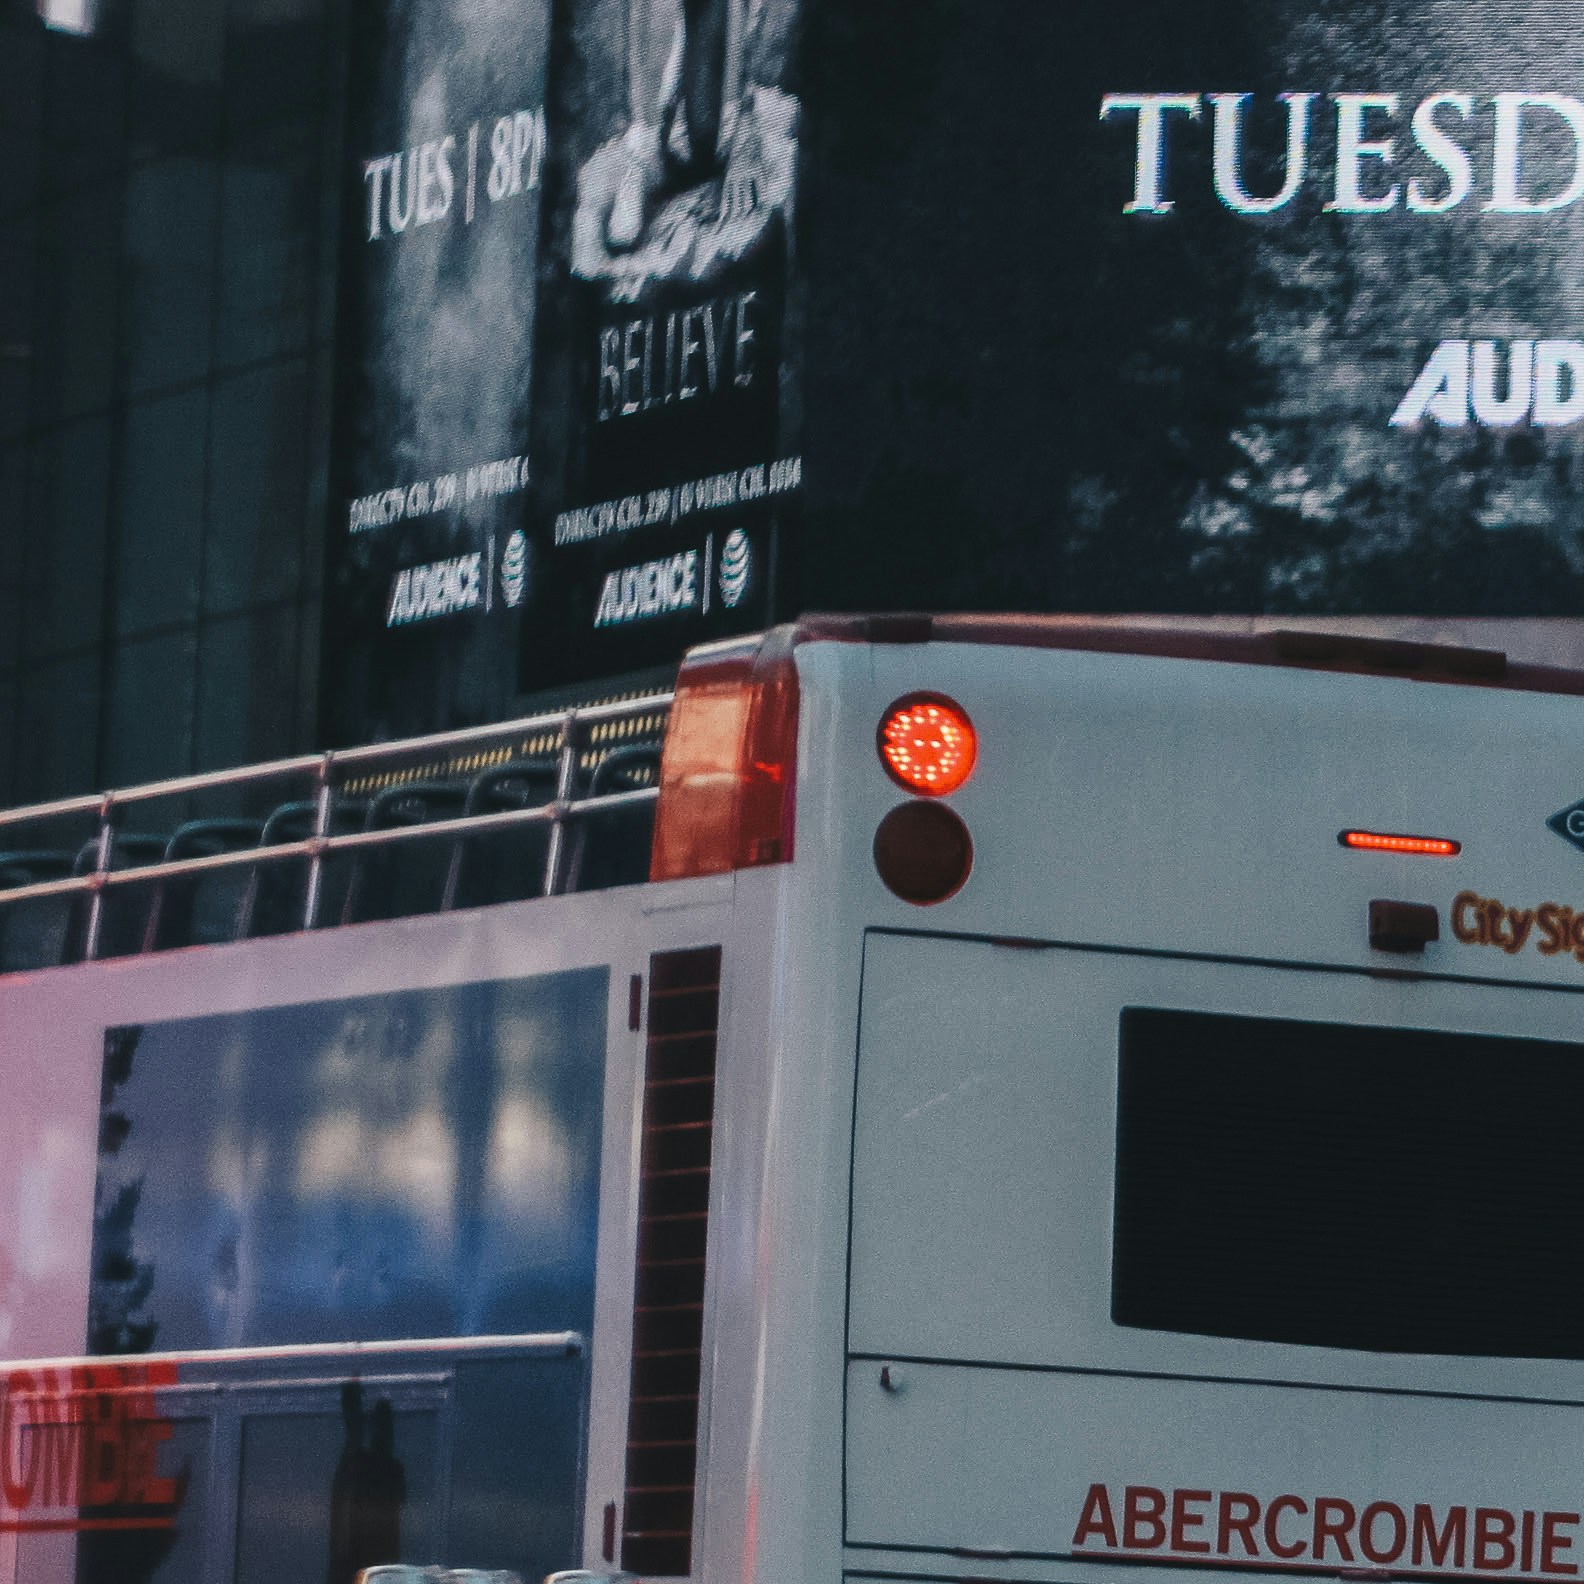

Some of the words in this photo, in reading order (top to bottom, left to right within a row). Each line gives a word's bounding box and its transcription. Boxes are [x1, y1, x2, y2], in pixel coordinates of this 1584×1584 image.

[363, 134, 457, 243] TUES
[598, 290, 758, 422] BELIEVE
[387, 552, 482, 628] AUDIENCE
[594, 549, 698, 629] AUDIENCE
[1452, 890, 1534, 955] City
[1072, 1483, 1581, 1576] ABERCROMBIE
